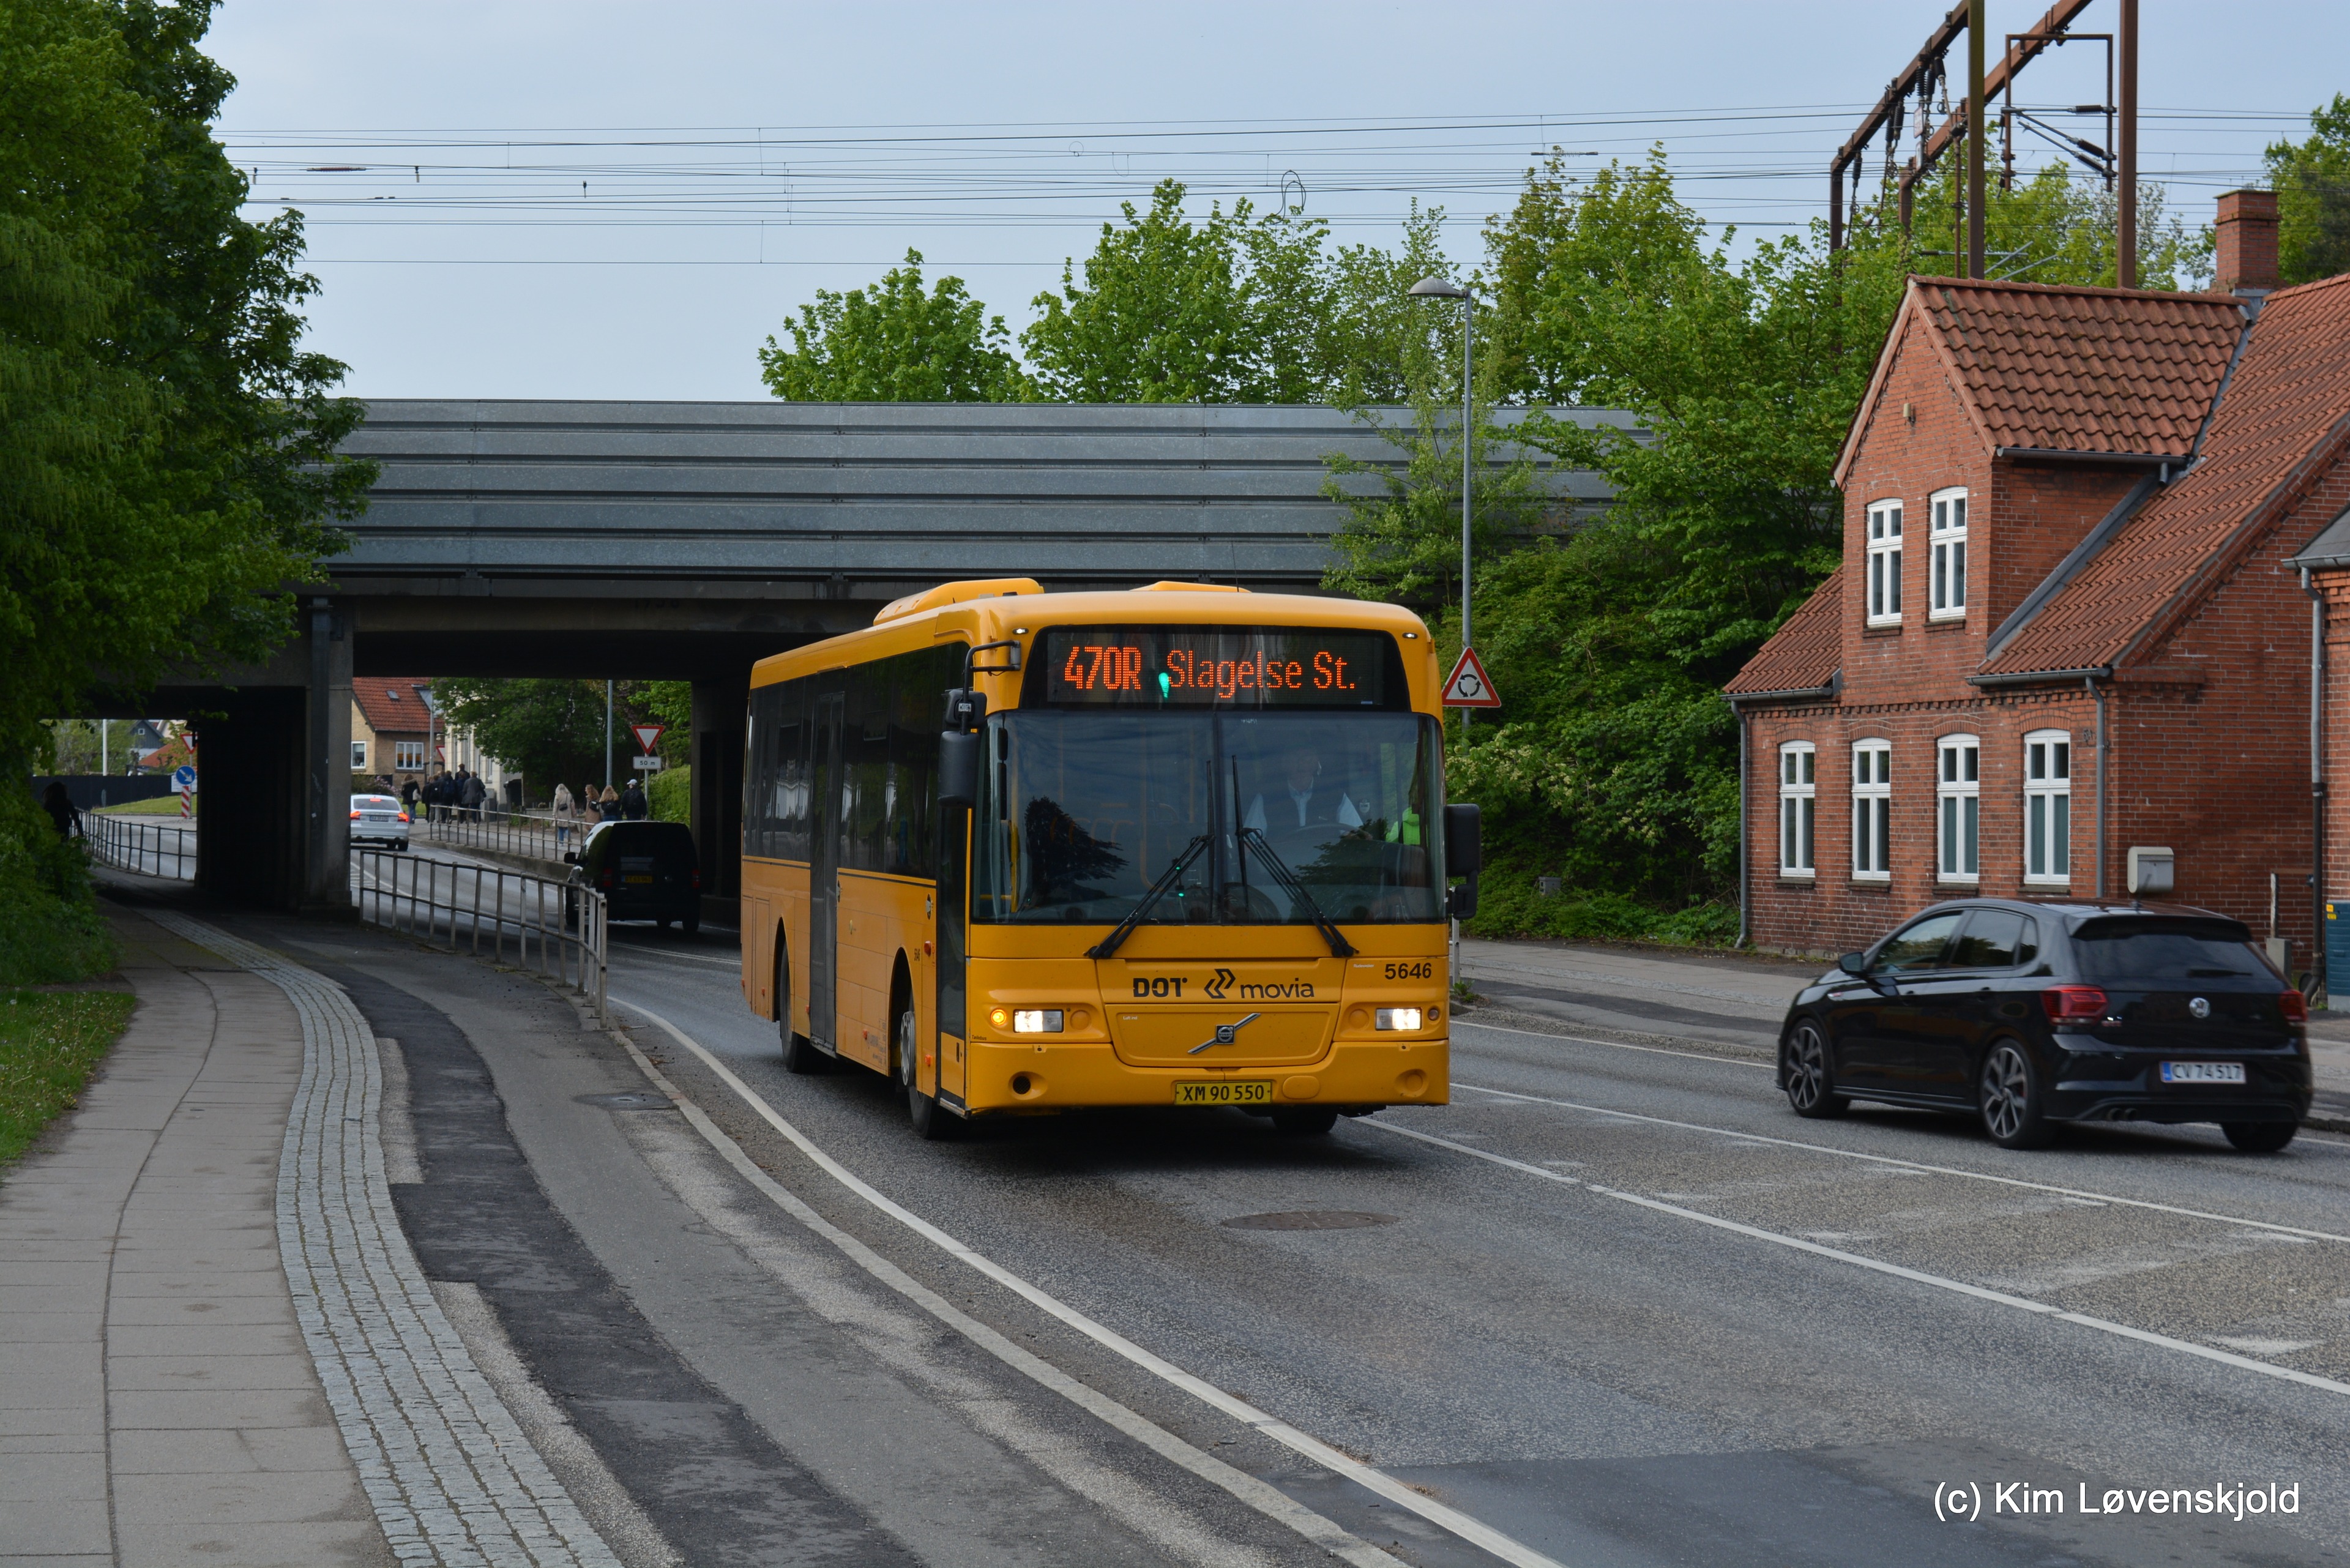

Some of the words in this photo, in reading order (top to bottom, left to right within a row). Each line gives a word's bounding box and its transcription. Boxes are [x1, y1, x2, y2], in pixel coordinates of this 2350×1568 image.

[1064, 646, 1141, 690] 470R
[1167, 649, 1302, 698] Slagelse
[1313, 651, 1355, 690] St.
[1384, 962, 1432, 980] 5646
[1133, 977, 1187, 998] DOT
[1240, 977, 1315, 998] movia
[2172, 1064, 2193, 1079] CV
[2195, 1064, 2214, 1079] 74
[2215, 1064, 2241, 1080] 517
[1183, 1086, 1206, 1101] XM
[1210, 1085, 1230, 1101] 90
[1234, 1085, 1264, 1100] 550
